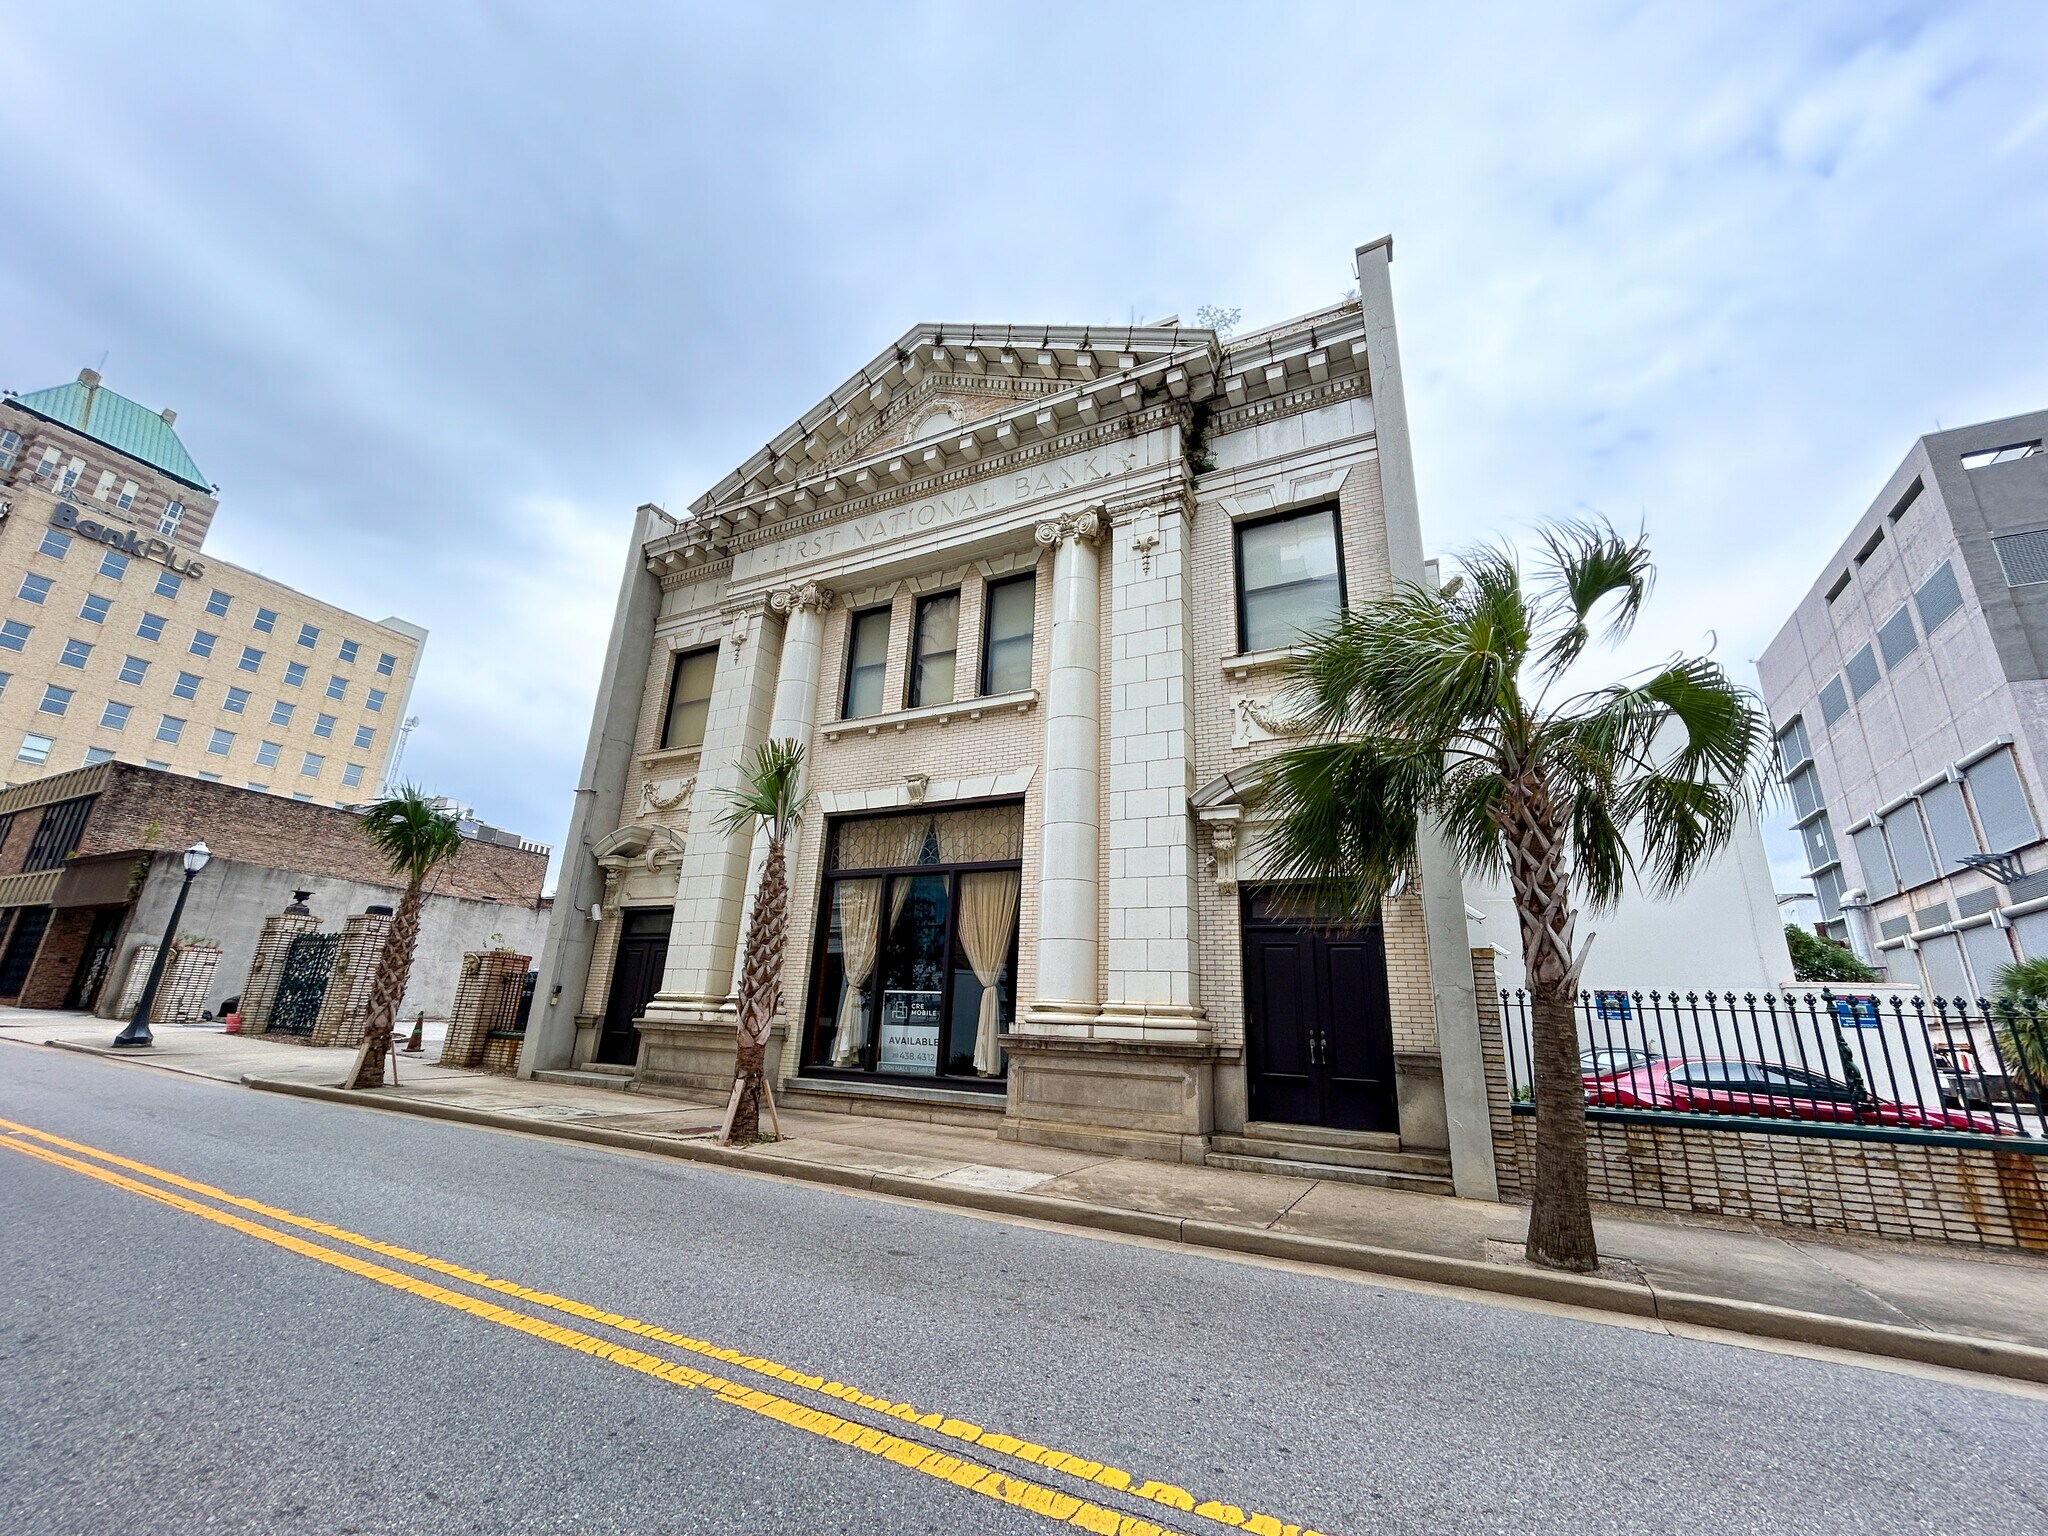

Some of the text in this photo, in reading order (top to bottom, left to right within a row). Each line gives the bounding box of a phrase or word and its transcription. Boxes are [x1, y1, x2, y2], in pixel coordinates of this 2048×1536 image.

[772, 456, 1103, 570] FIRST NATIONAL BANK
[49, 502, 205, 580] BankPlus
[889, 1036, 939, 1046] AVAILABLE
[899, 1051, 936, 1062] 438.4312
